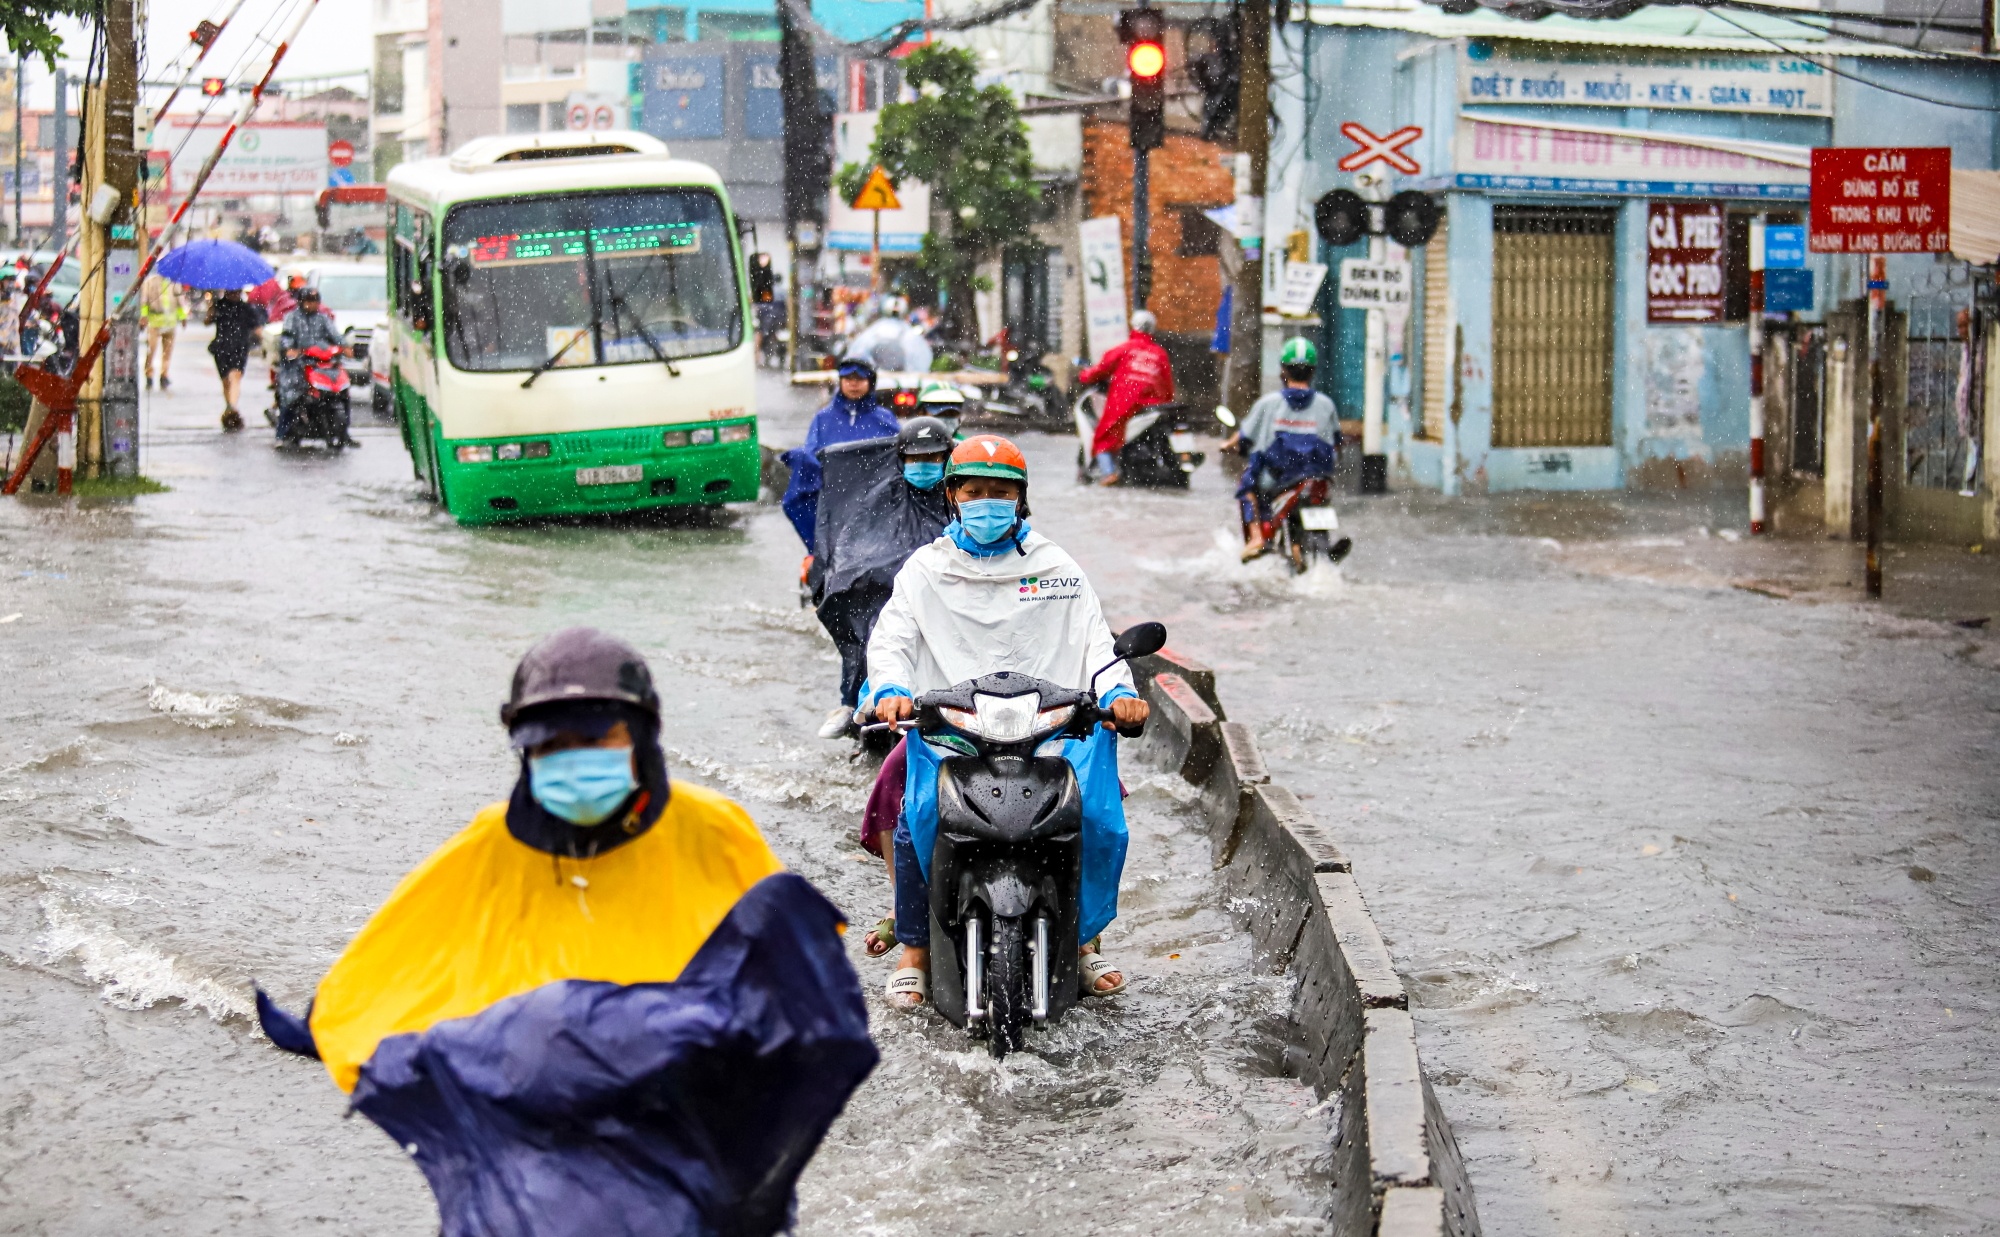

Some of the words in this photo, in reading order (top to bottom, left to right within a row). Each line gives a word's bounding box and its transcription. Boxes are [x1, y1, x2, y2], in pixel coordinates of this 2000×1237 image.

[1903, 180, 1919, 197] XE
[1830, 205, 1870, 223] TRONG
[1876, 206, 1901, 223] KHU
[1848, 233, 1879, 251] LANG
[994, 755, 1025, 763] HONDA
